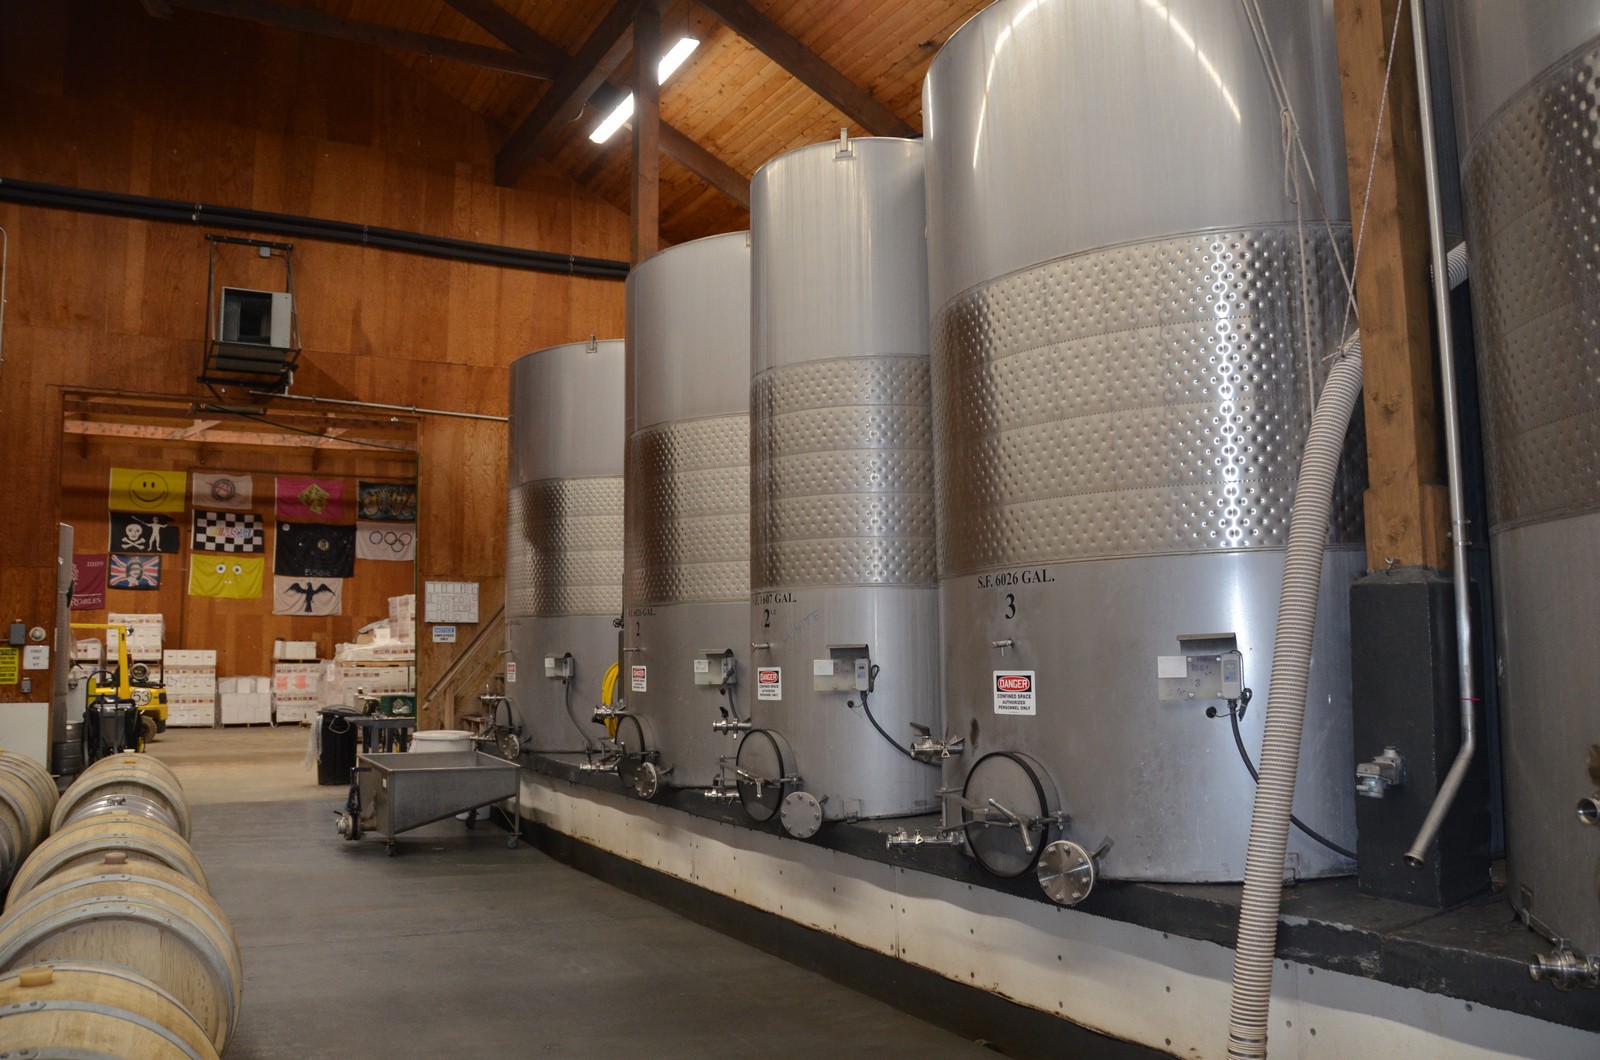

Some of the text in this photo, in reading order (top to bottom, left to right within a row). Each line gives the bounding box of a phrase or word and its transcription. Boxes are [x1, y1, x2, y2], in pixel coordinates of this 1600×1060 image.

[86, 560, 104, 568] 1889
[995, 571, 1018, 586] 6026
[1021, 569, 1055, 584] GAL.
[70, 596, 102, 607] ROBLES
[760, 594, 773, 605] 1607
[774, 592, 797, 604] GAL.
[1005, 593, 1016, 619] 3
[763, 608, 771, 628] 2
[760, 673, 778, 681] DANGER
[999, 679, 1028, 689] DANGER
[132, 690, 150, 703] 53
